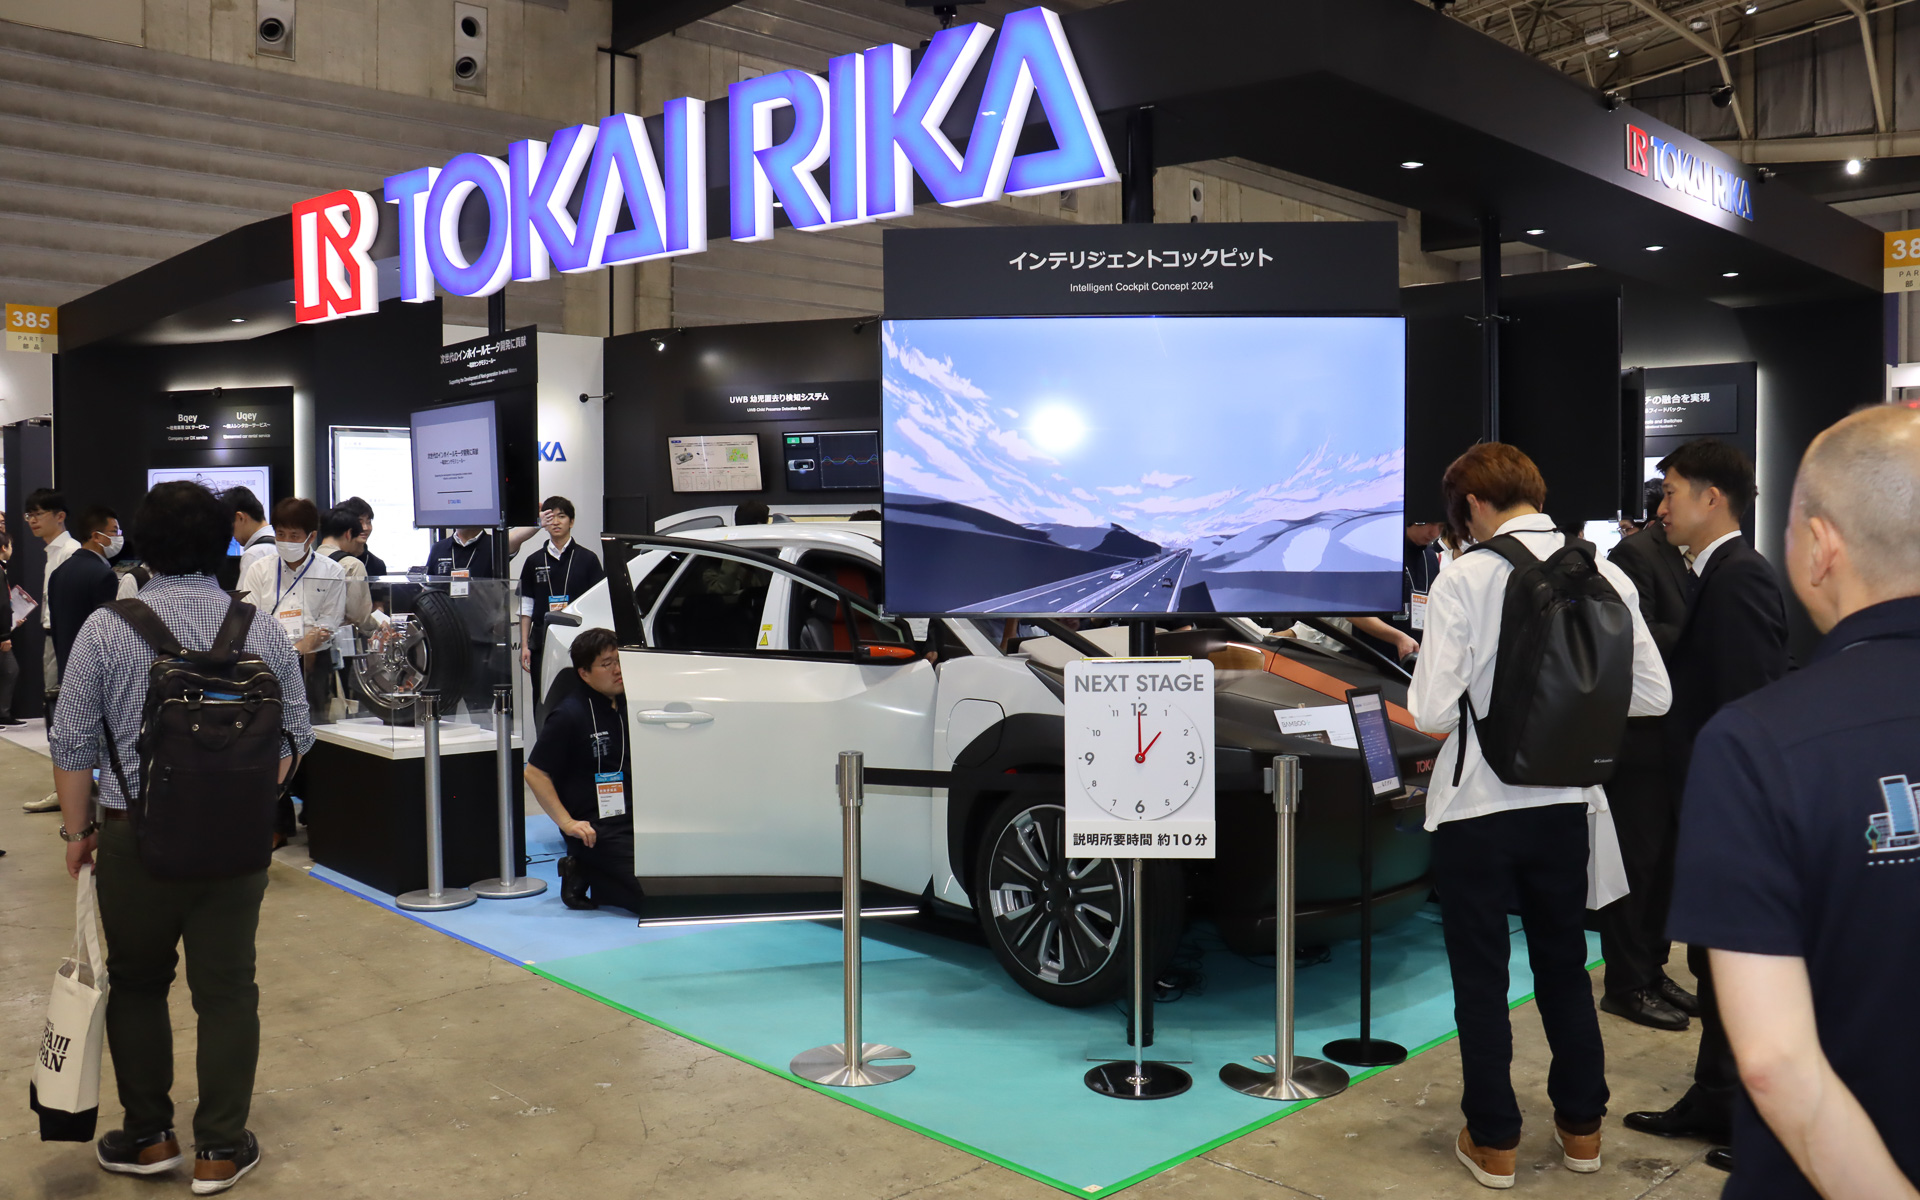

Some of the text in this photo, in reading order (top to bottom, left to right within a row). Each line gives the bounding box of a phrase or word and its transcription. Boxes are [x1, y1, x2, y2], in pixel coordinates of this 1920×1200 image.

[384, 97, 707, 301] TOKAI
[729, 6, 1120, 241] RIKA
[1650, 135, 1709, 203] TOKAI
[1711, 165, 1753, 222] RIKA
[1009, 247, 1273, 271] インテリジェントコックピット
[1070, 281, 1214, 293] Intelligent Cockpit Concept 2024
[12, 310, 50, 329] 385
[17, 335, 45, 343] PARTS
[729, 396, 749, 404] UWB
[178, 414, 198, 423] Bqey
[236, 412, 257, 422] Uqey
[1074, 674, 1204, 693] NEXT STAGE
[1131, 702, 1148, 716] 12
[1084, 752, 1094, 765] 9
[1186, 752, 1196, 765] 3
[1135, 800, 1145, 813] 6
[1073, 833, 1208, 846] 説明所要時間 約10分
